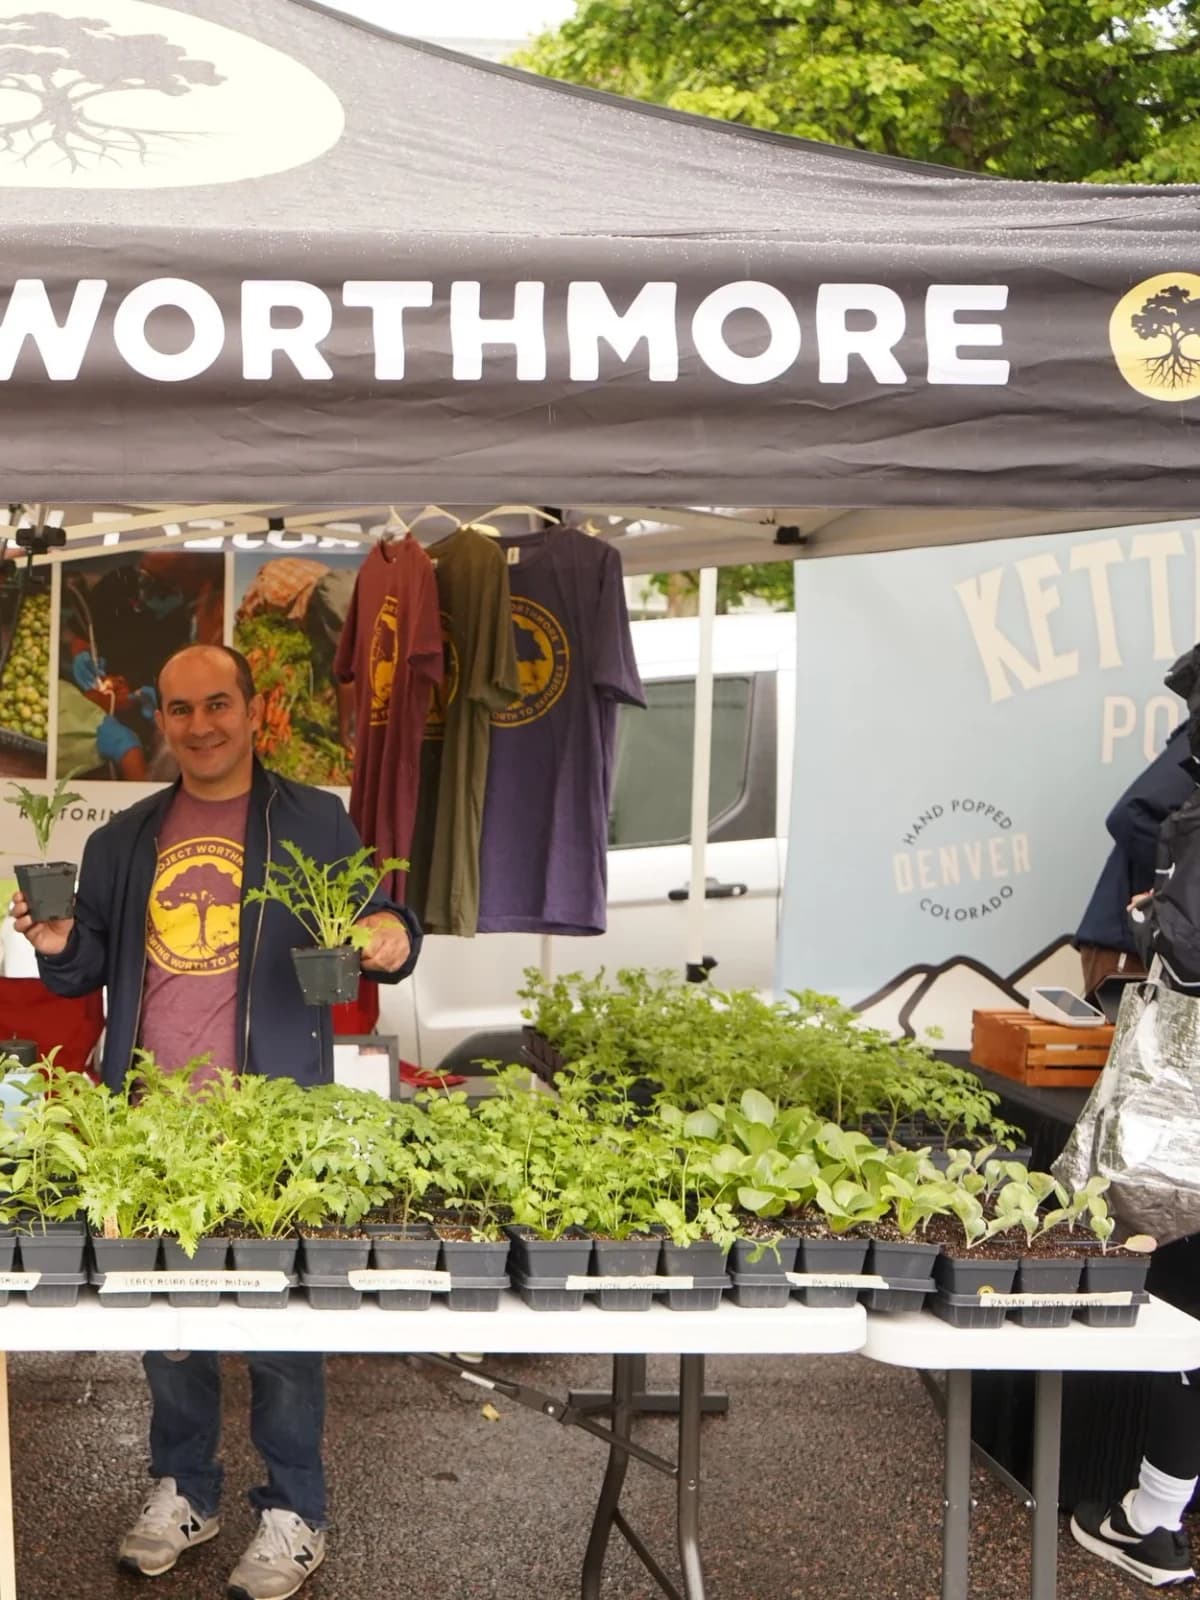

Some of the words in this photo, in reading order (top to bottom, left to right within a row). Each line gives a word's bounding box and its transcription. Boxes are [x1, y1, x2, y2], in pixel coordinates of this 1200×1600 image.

[954, 529, 1200, 704] KETT
[903, 804, 945, 846] HAND
[951, 798, 1013, 830] POPPED
[892, 832, 1032, 894] DENVER
[919, 884, 1014, 921] COLORADO
[209, 957, 228, 969] TO
